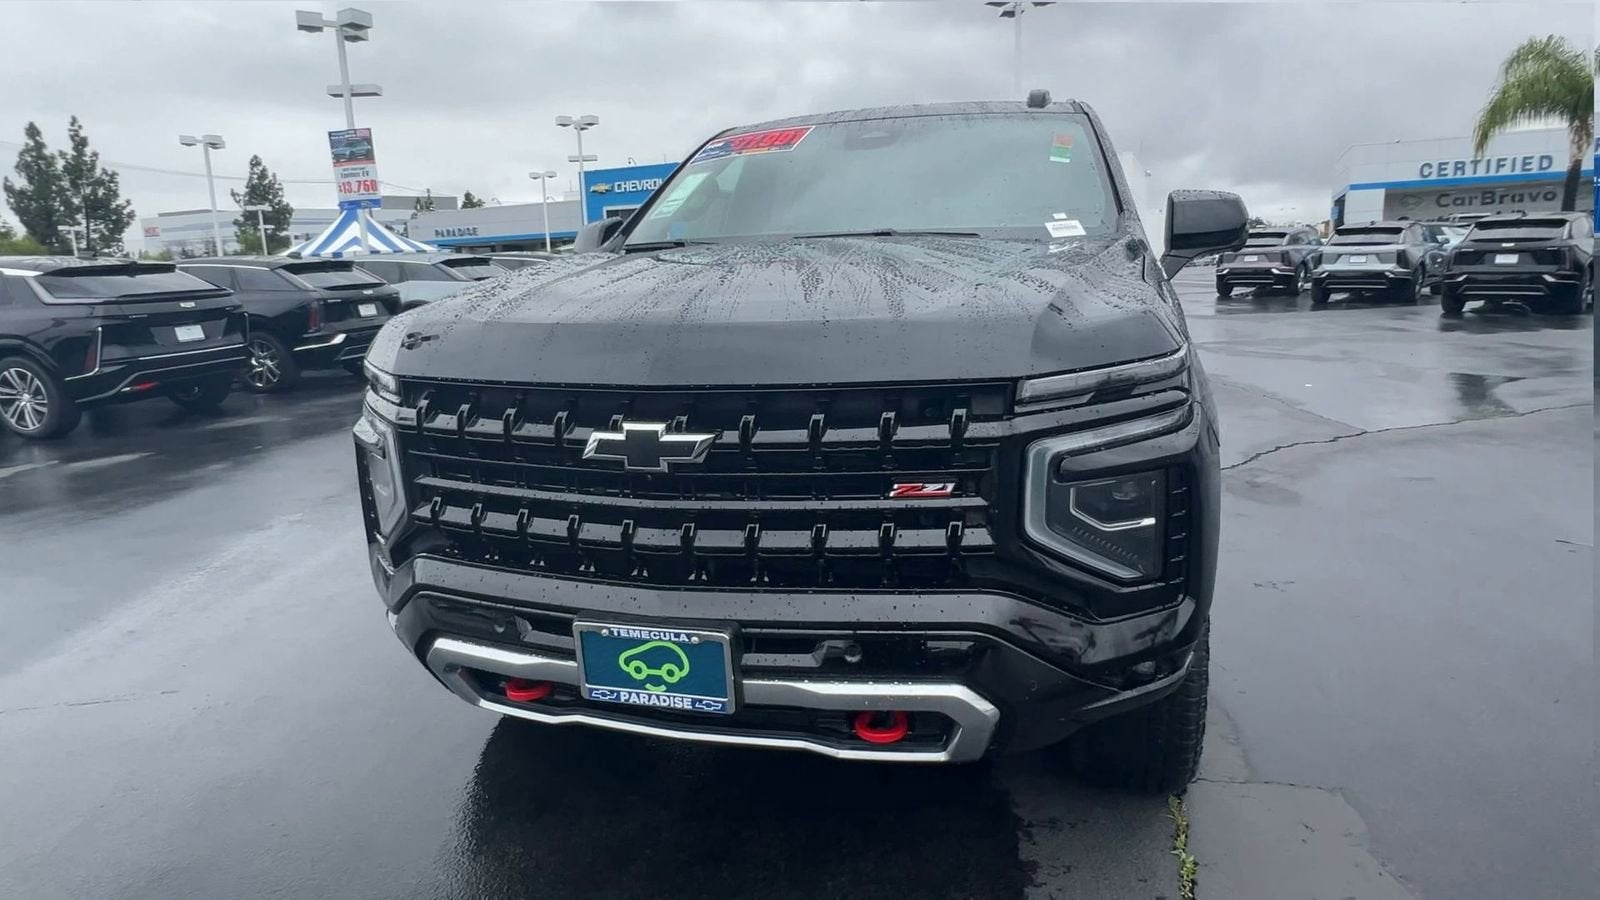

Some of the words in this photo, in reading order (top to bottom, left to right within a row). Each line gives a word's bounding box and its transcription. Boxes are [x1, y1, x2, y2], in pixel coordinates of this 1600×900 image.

[1420, 155, 1553, 178] CERTIFIED
[1435, 190, 1557, 208] CarBravo
[434, 227, 479, 238] PARADISE
[610, 627, 690, 643] TEMECULA
[619, 691, 693, 709] PARADISE
